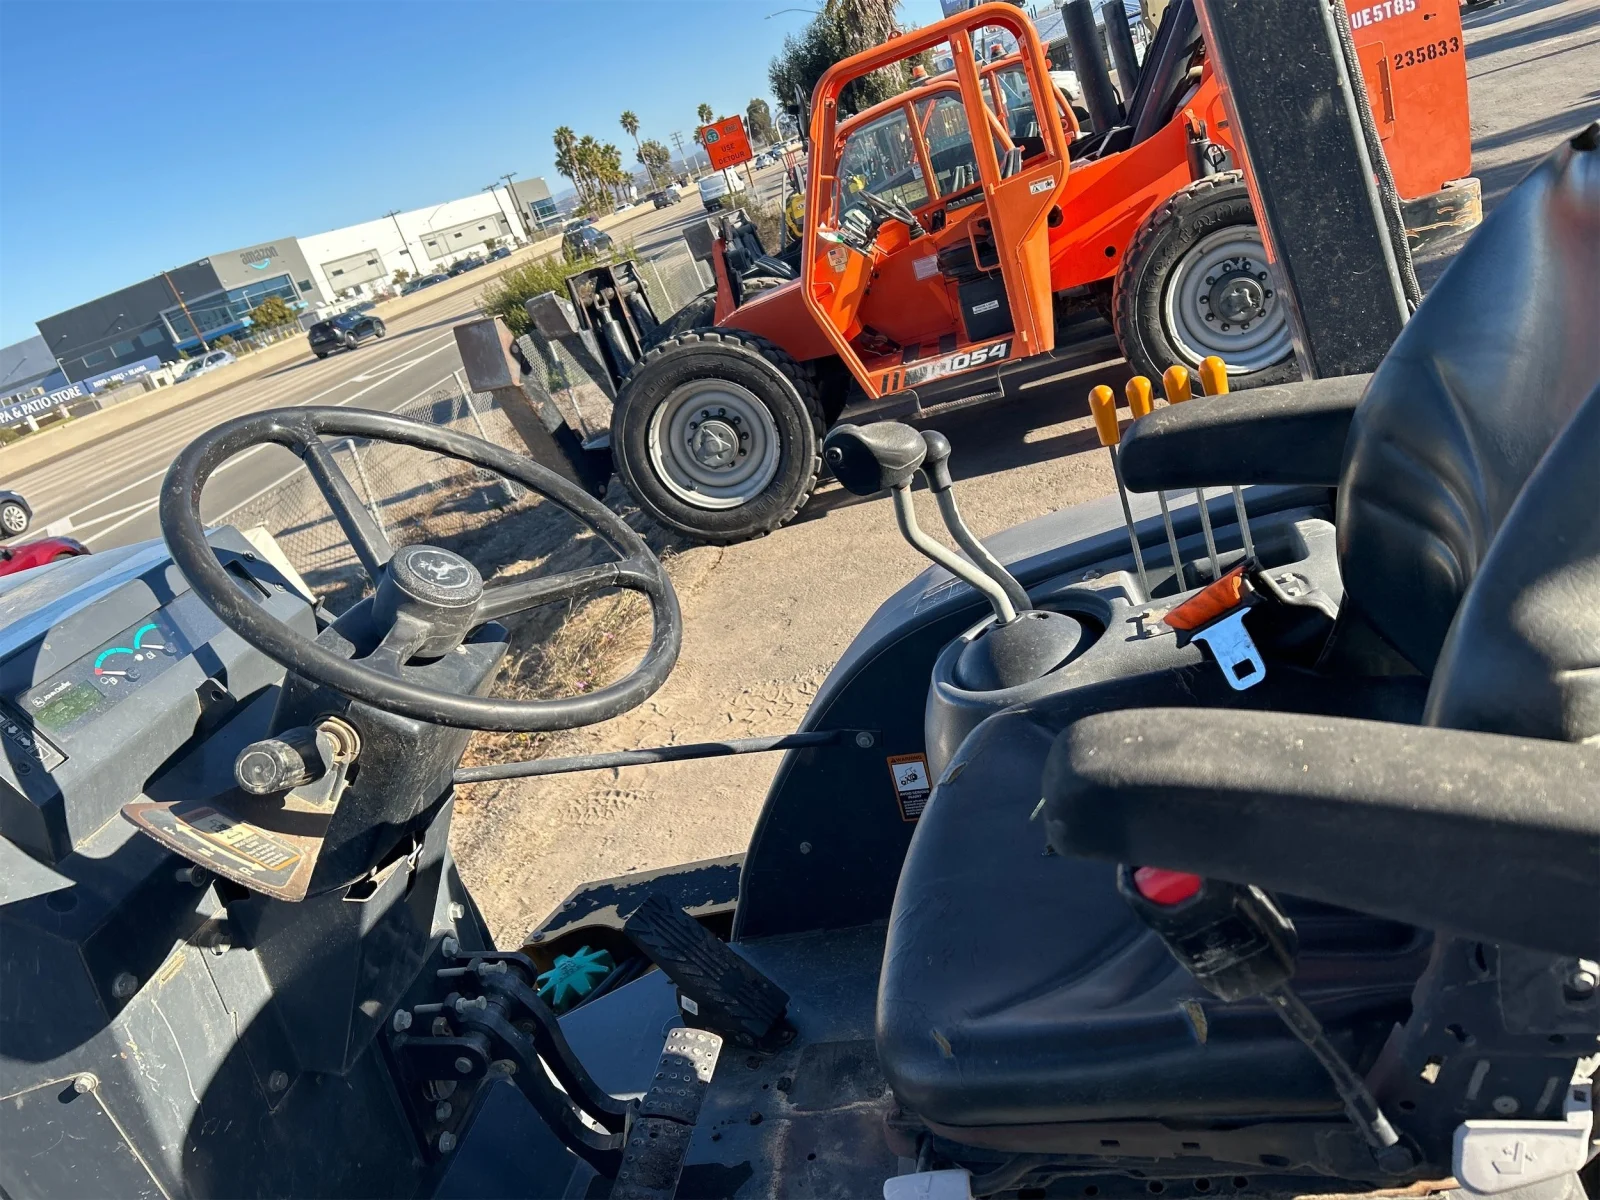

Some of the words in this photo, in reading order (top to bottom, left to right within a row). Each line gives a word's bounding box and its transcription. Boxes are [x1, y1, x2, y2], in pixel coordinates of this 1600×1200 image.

[1394, 37, 1459, 70] 235833
[708, 134, 717, 142] 52
[722, 143, 735, 152] USE
[719, 151, 744, 164] DETOUR
[240, 246, 278, 265] amazon
[12, 407, 22, 419] &
[22, 398, 51, 415] PATIO
[52, 387, 82, 404] STORE
[163, 826, 176, 836] F
[239, 866, 255, 876] R
